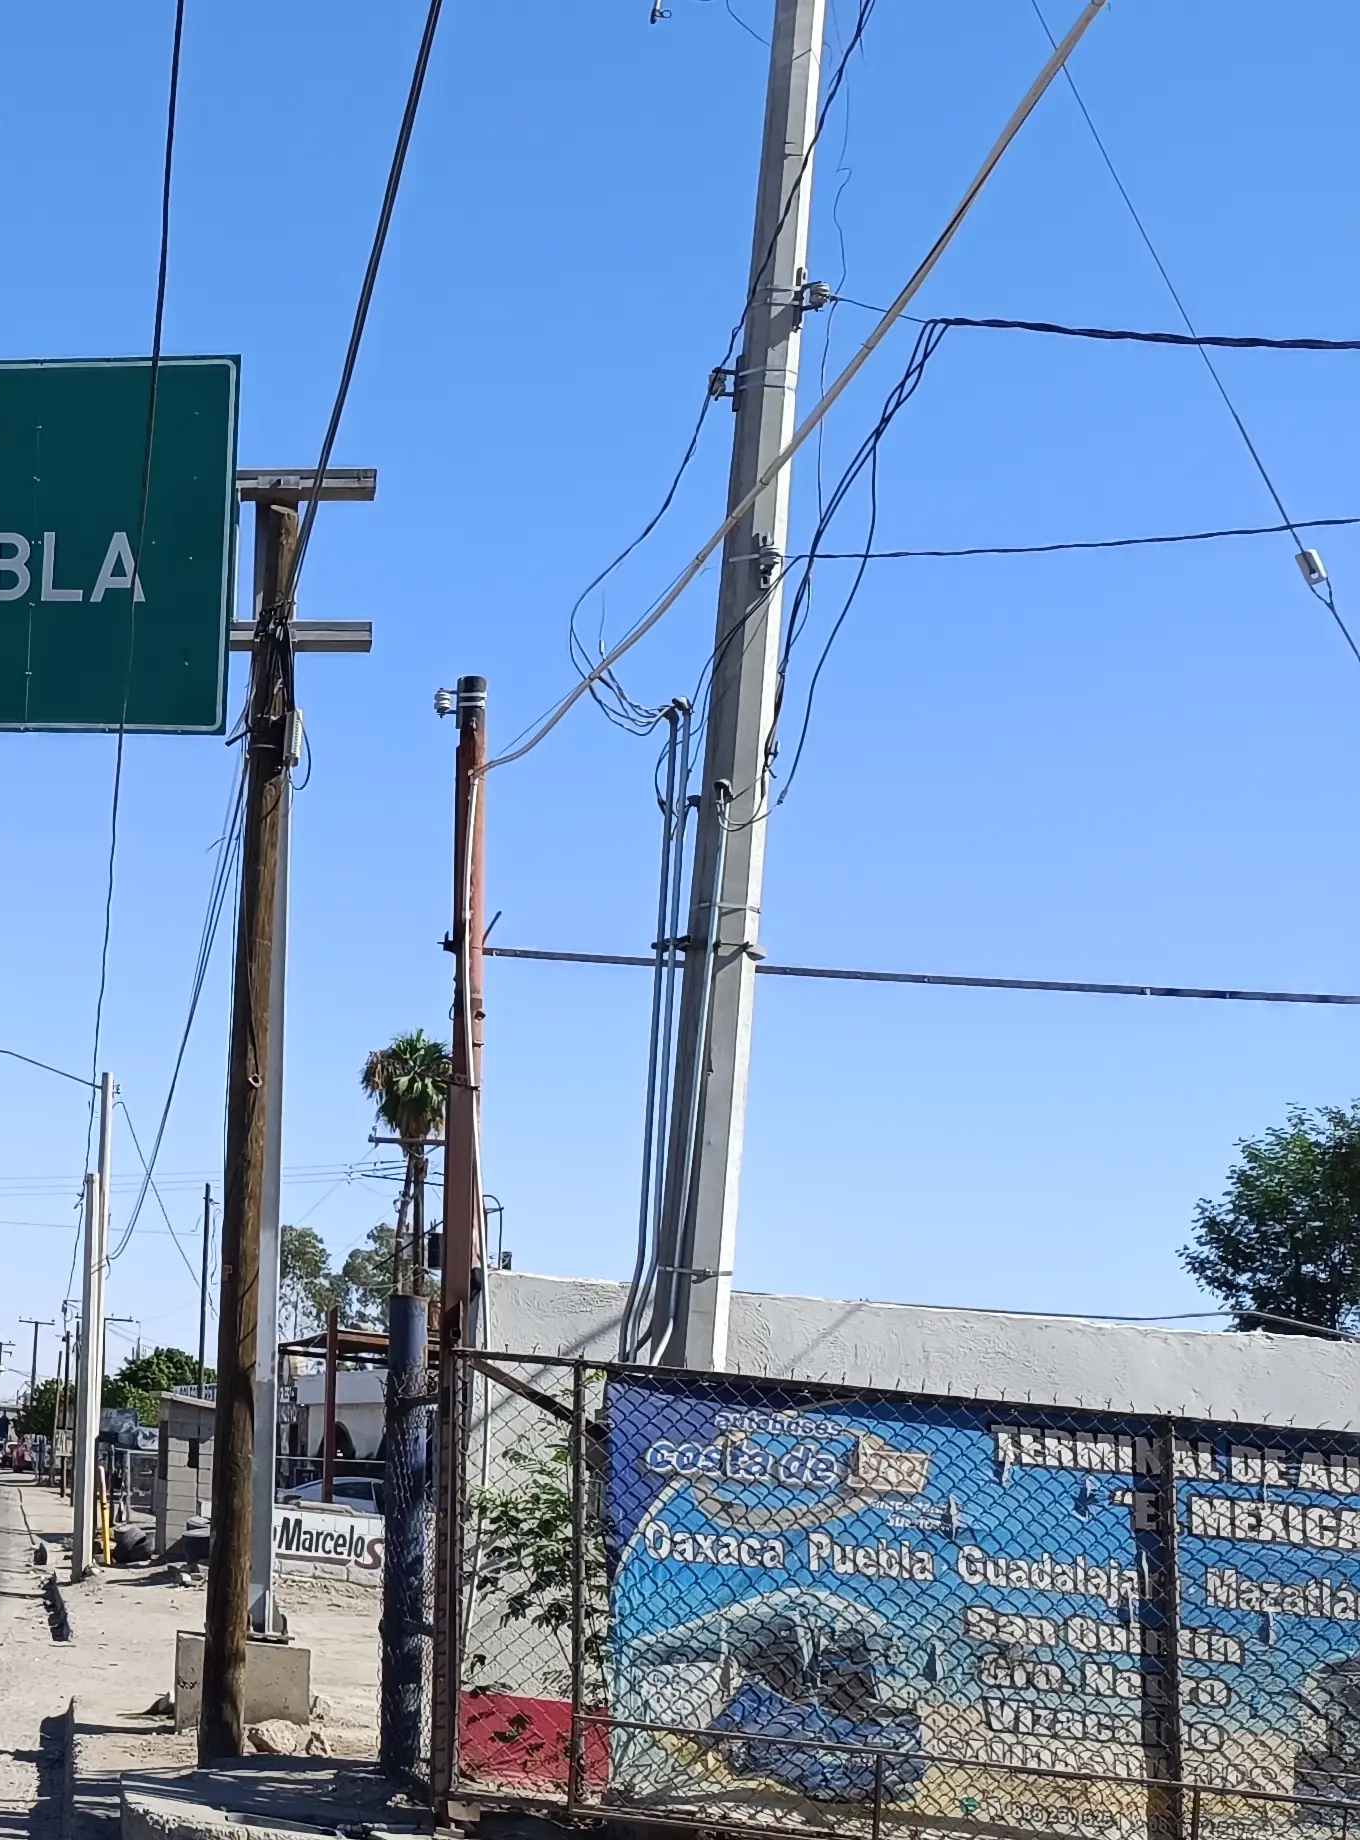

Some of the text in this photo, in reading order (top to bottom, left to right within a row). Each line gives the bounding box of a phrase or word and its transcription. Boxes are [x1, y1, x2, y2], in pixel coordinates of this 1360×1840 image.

[991, 1424, 1221, 1481] TERMINAL
[1230, 1445, 1289, 1489] DE
[643, 1523, 784, 1570] Oaxaca
[809, 1541, 934, 1582] Puebla
